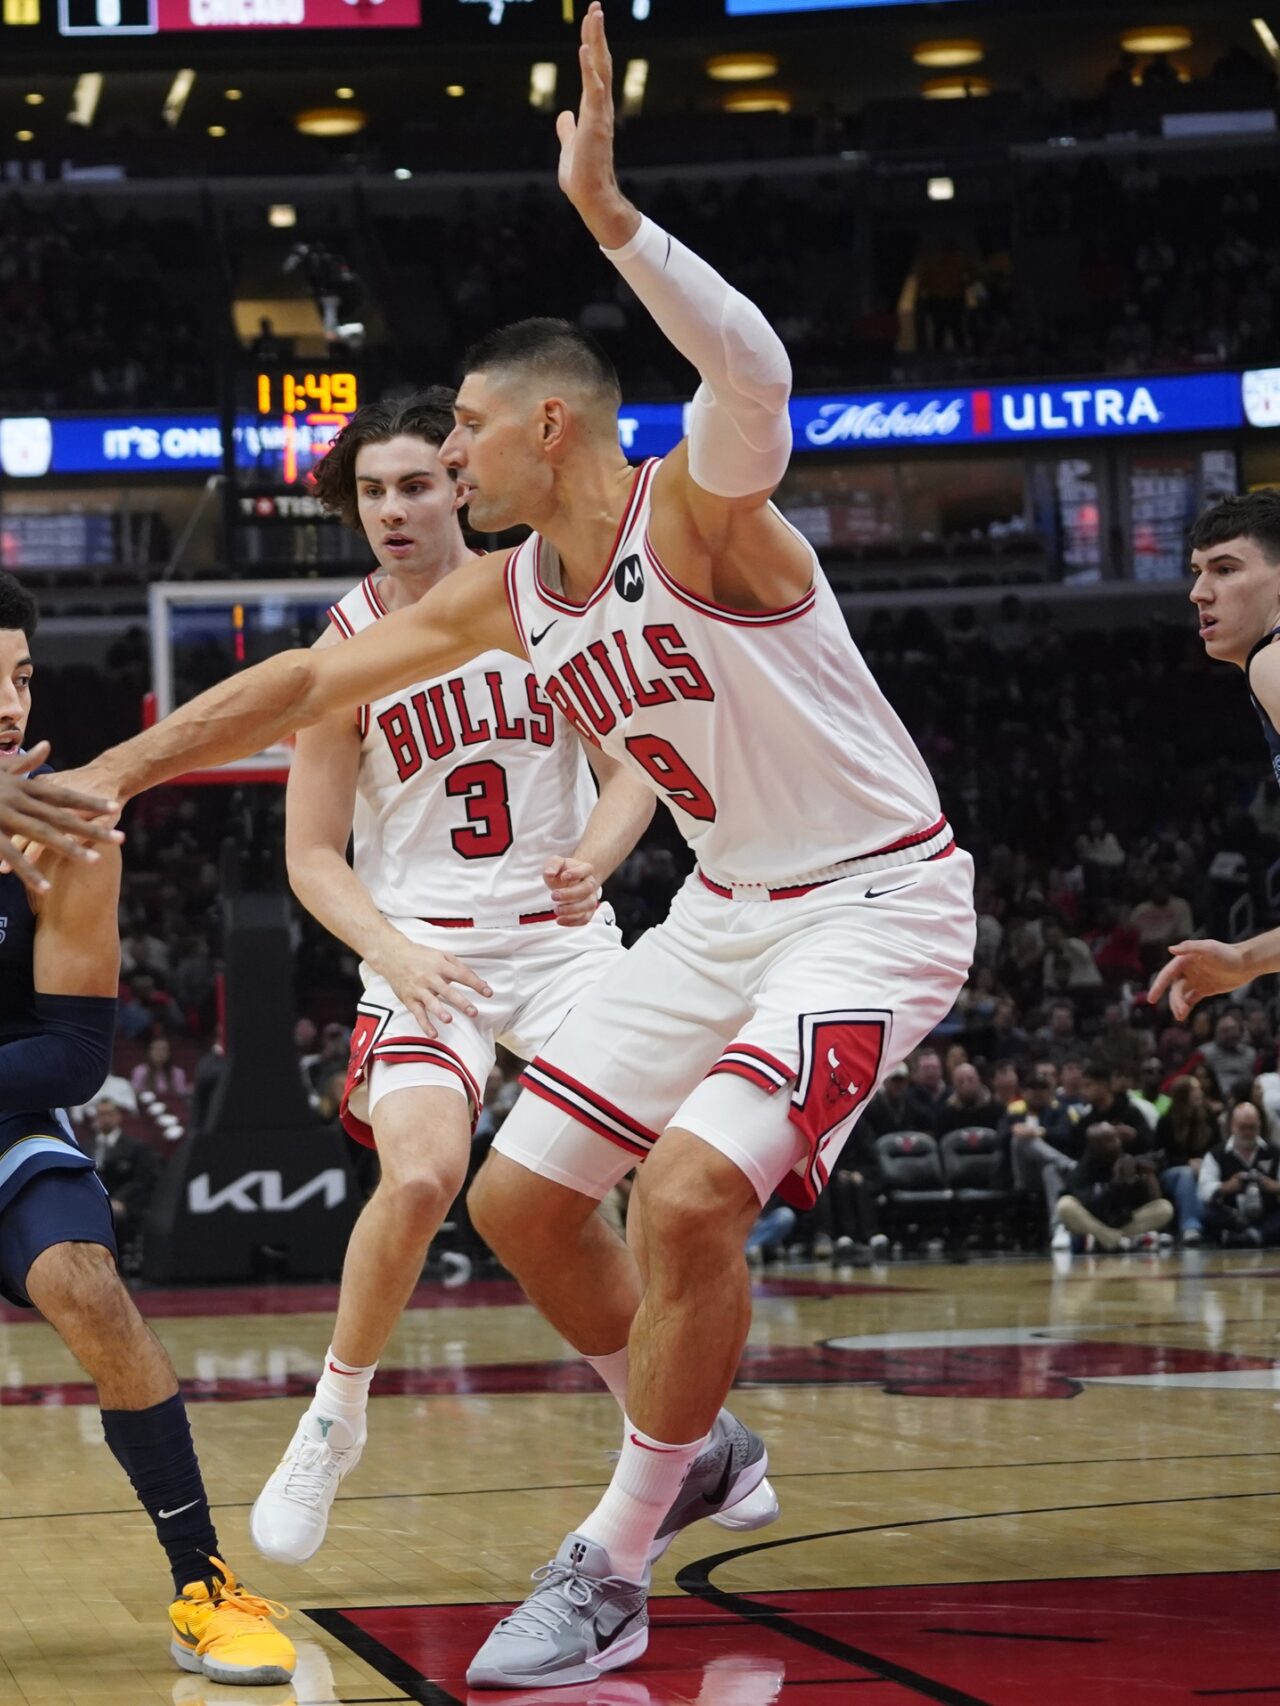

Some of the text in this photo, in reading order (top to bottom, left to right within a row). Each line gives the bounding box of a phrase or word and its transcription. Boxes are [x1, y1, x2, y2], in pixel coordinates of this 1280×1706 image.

[257, 373, 358, 414] 11:49
[805, 387, 1162, 446] Michelob ULTRA
[103, 426, 161, 460] IT'S
[548, 623, 716, 751] BULLS
[377, 671, 556, 784] BULLS
[445, 759, 514, 860] 3
[624, 733, 717, 824] 9
[188, 1168, 346, 1213] KIA
